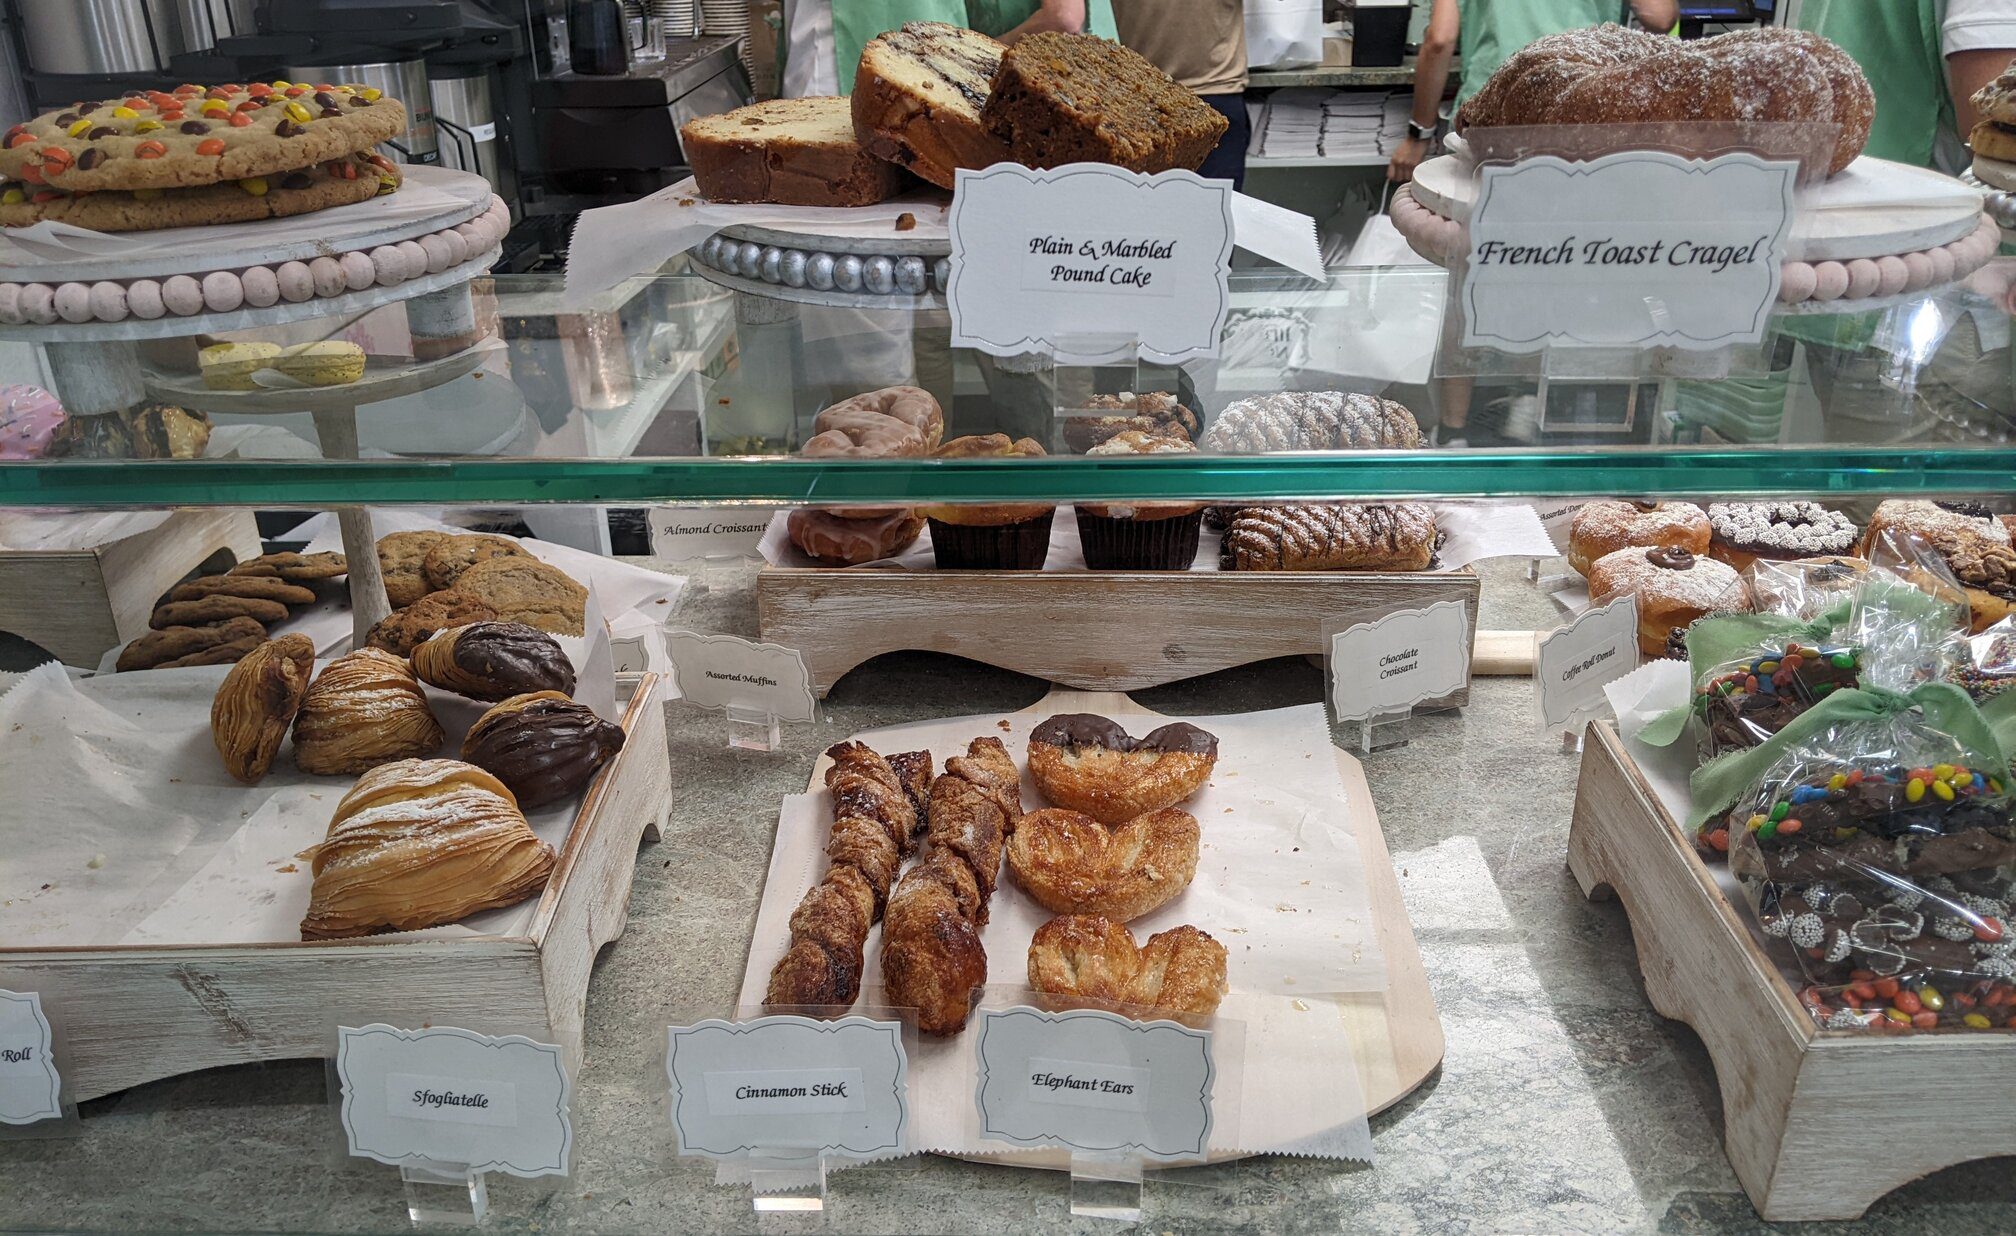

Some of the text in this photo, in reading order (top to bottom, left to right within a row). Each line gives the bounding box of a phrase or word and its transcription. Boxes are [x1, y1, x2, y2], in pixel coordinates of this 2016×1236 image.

[1029, 235, 1178, 261] Plain & Marbled
[1477, 236, 1769, 273] French Toast Cragel
[1050, 264, 1152, 288] Pound Cake
[1540, 505, 1568, 520] Assorted
[664, 522, 768, 536] Almond Croissant
[1379, 648, 1419, 667] Chocolate
[1562, 645, 1616, 681] Coffee Roll Donut
[705, 670, 778, 687] Assorted Muffins
[1380, 660, 1418, 680] Croissant
[1, 1047, 33, 1063] Roll
[735, 1081, 849, 1100] Cinnamon Stick
[1031, 1072, 1135, 1095] Elephant Ears
[412, 1089, 489, 1108] Sfogliatelle
